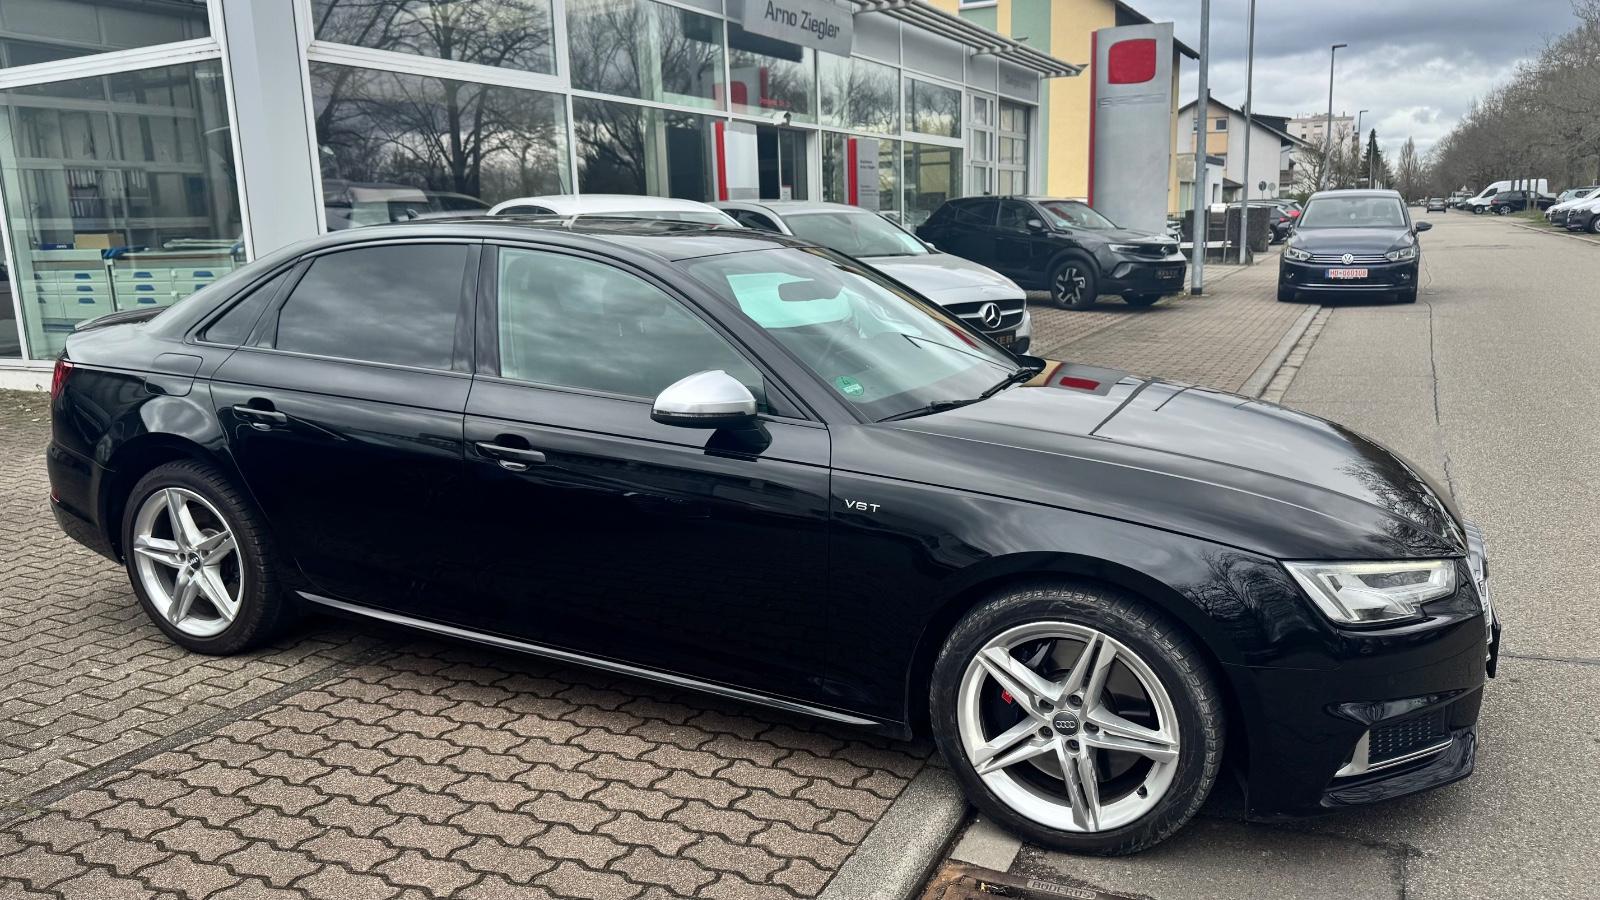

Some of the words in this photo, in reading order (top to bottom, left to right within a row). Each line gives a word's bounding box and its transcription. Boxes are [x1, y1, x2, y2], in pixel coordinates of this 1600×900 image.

[764, 0, 798, 27] Arno
[800, 10, 840, 39] Ziegler
[845, 499, 880, 512] V6T
[1031, 880, 1093, 899] BUDERUS
